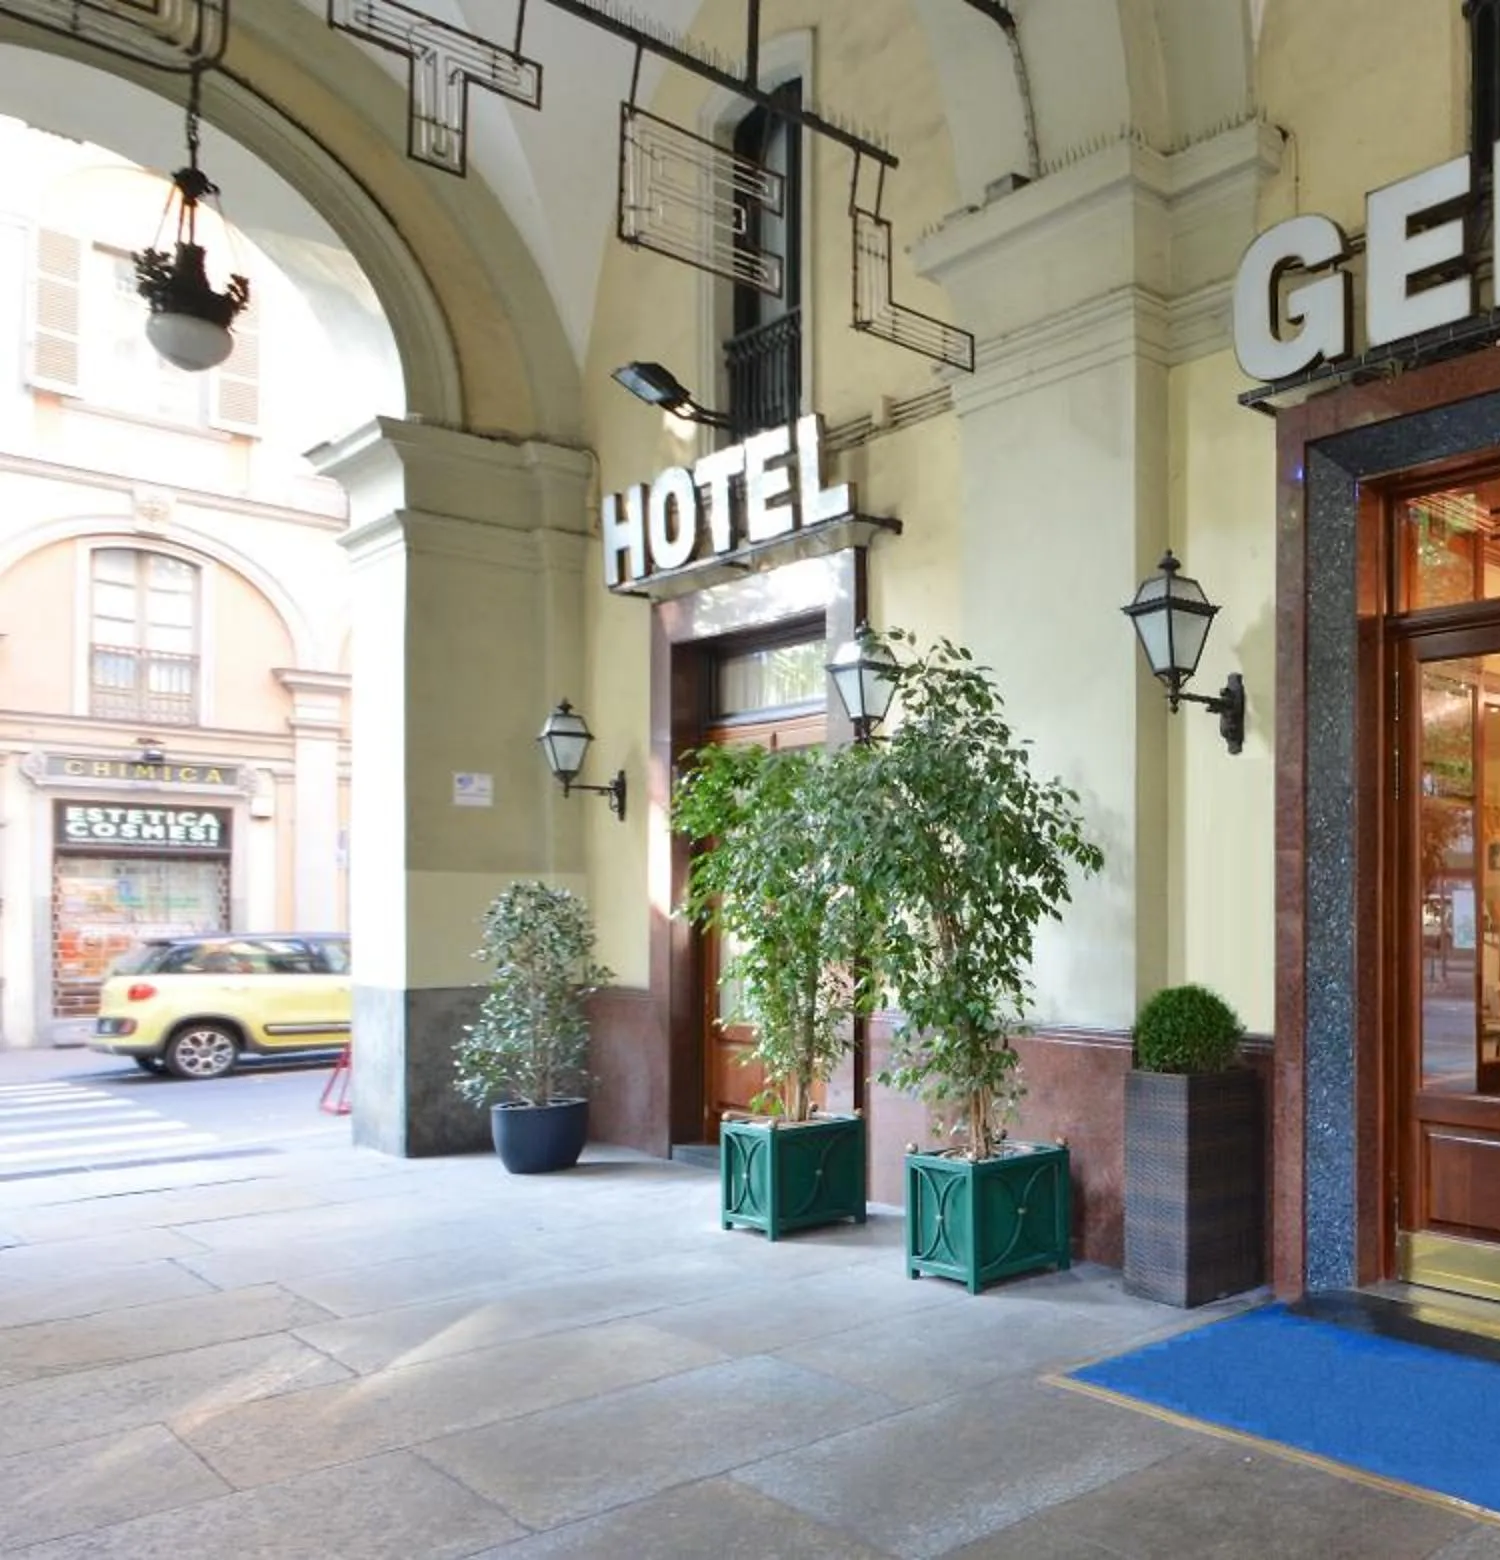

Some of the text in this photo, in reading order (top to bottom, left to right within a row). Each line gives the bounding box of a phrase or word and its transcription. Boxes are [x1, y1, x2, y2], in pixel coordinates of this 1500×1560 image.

[603, 414, 855, 586] HOTEL
[63, 759, 223, 784] CHIMICA
[65, 806, 219, 826] ESTETICA
[66, 822, 220, 841] COSMESI
